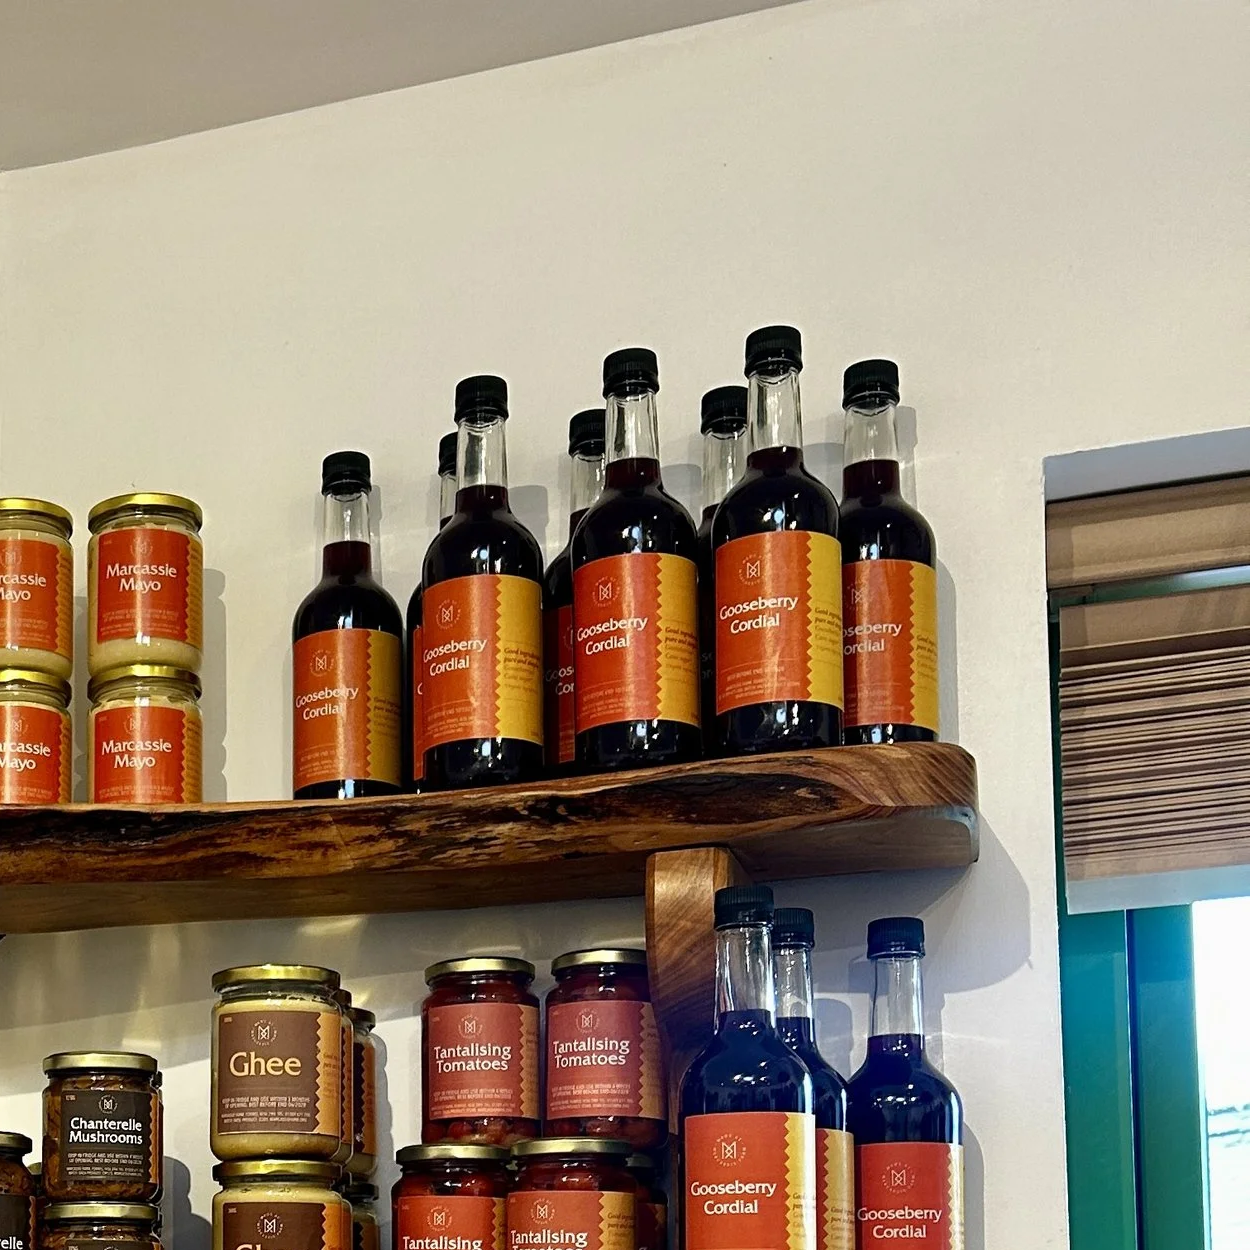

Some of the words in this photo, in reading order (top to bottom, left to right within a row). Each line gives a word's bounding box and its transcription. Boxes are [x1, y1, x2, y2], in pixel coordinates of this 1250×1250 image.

[106, 563, 177, 579] Marcassie
[119, 577, 161, 594] Mayo
[719, 595, 798, 621] Gooseberry
[577, 616, 648, 642] Gooseberry
[730, 612, 780, 634] Cordial
[423, 637, 488, 663] Gooseberry
[585, 634, 630, 656] Cordial
[844, 638, 885, 656] ordial
[430, 656, 470, 676] Cordial
[295, 685, 358, 707] Gooseberry
[303, 703, 344, 720] Cordial
[102, 739, 172, 755] Marcassie
[114, 754, 156, 770] Mayo
[434, 1043, 512, 1060] Tantalising
[553, 1037, 630, 1054] Tantalising
[229, 1052, 301, 1077] Ghee
[436, 1058, 508, 1073] Tomatoes
[555, 1052, 626, 1068] Tomatoes
[70, 1117, 142, 1132] Chanterelle
[69, 1131, 143, 1144] Mushrooms
[691, 1180, 777, 1198] Gooseberry
[704, 1200, 758, 1215] Cordial
[857, 1206, 942, 1223] Gooseberry
[511, 1229, 588, 1248] Tantalising
[873, 1225, 926, 1239] Cordial
